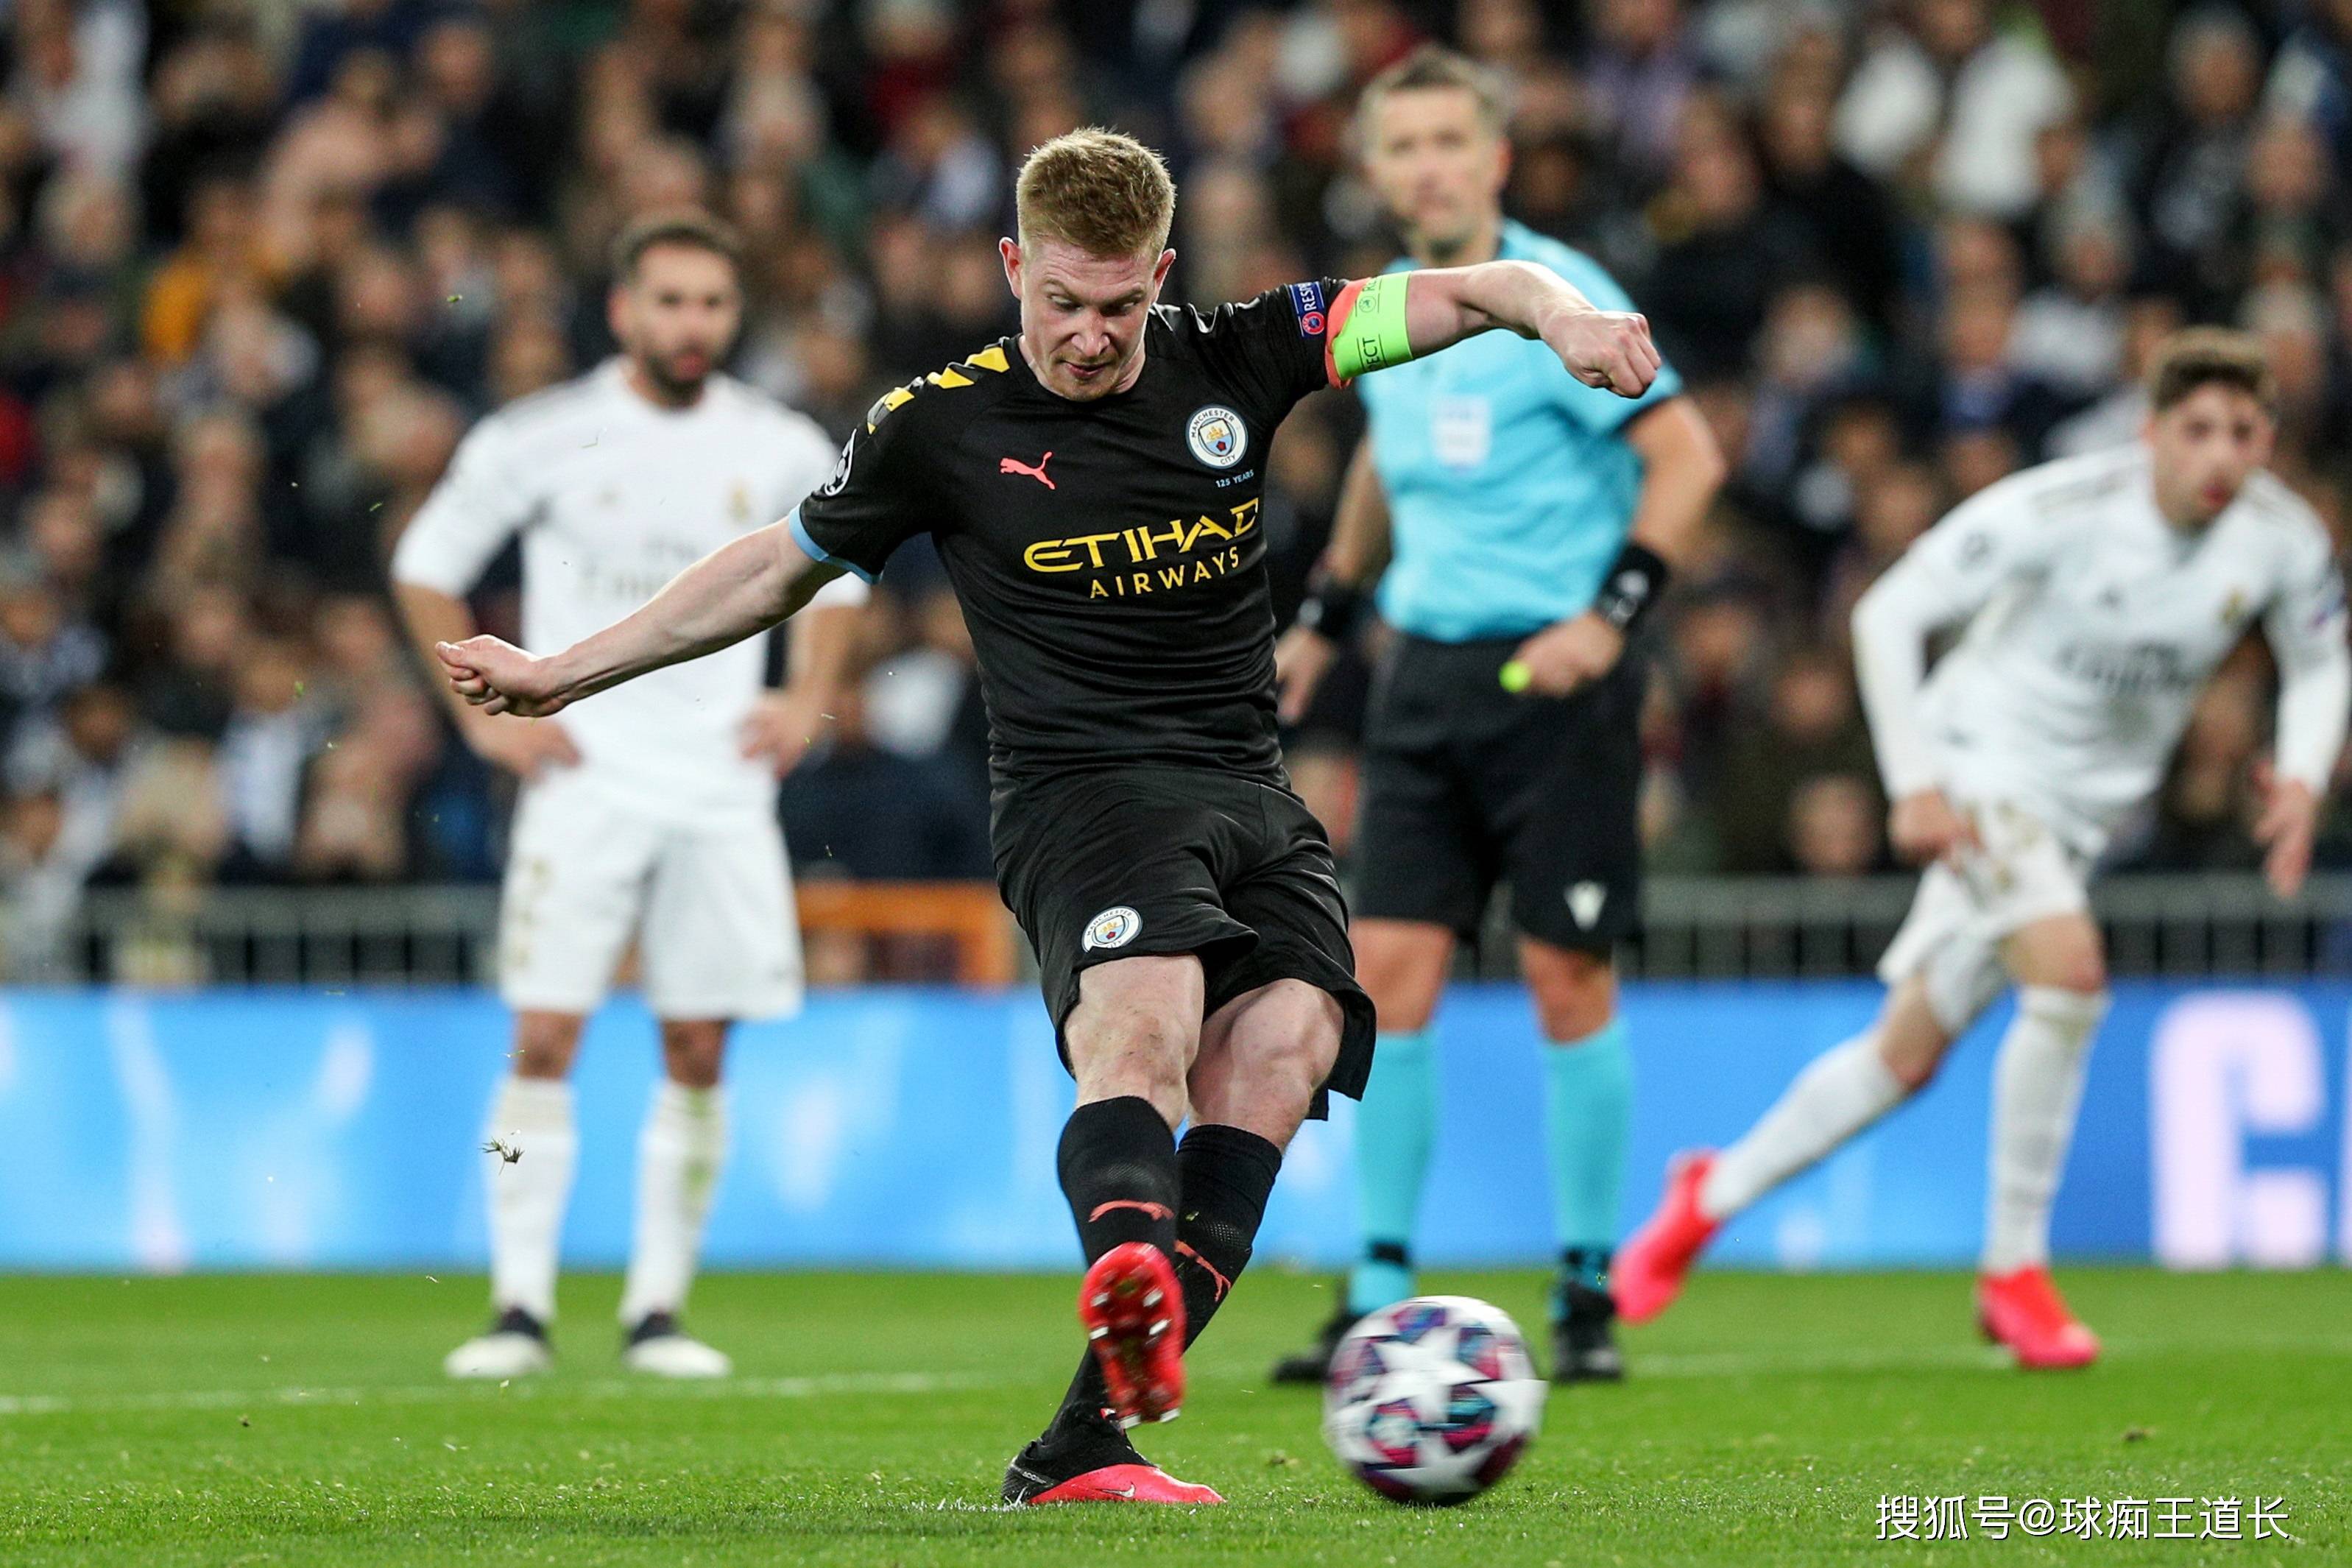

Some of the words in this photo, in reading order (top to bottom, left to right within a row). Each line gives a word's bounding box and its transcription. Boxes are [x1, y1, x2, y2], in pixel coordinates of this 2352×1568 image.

[1191, 409, 1235, 438] MANCHESTER
[1220, 454, 1236, 465] CITY
[1215, 478, 1231, 487] 125
[1232, 469, 1254, 484] YEARS
[1023, 497, 1259, 573] ETIHAD
[1090, 545, 1240, 599] AIRWAYS
